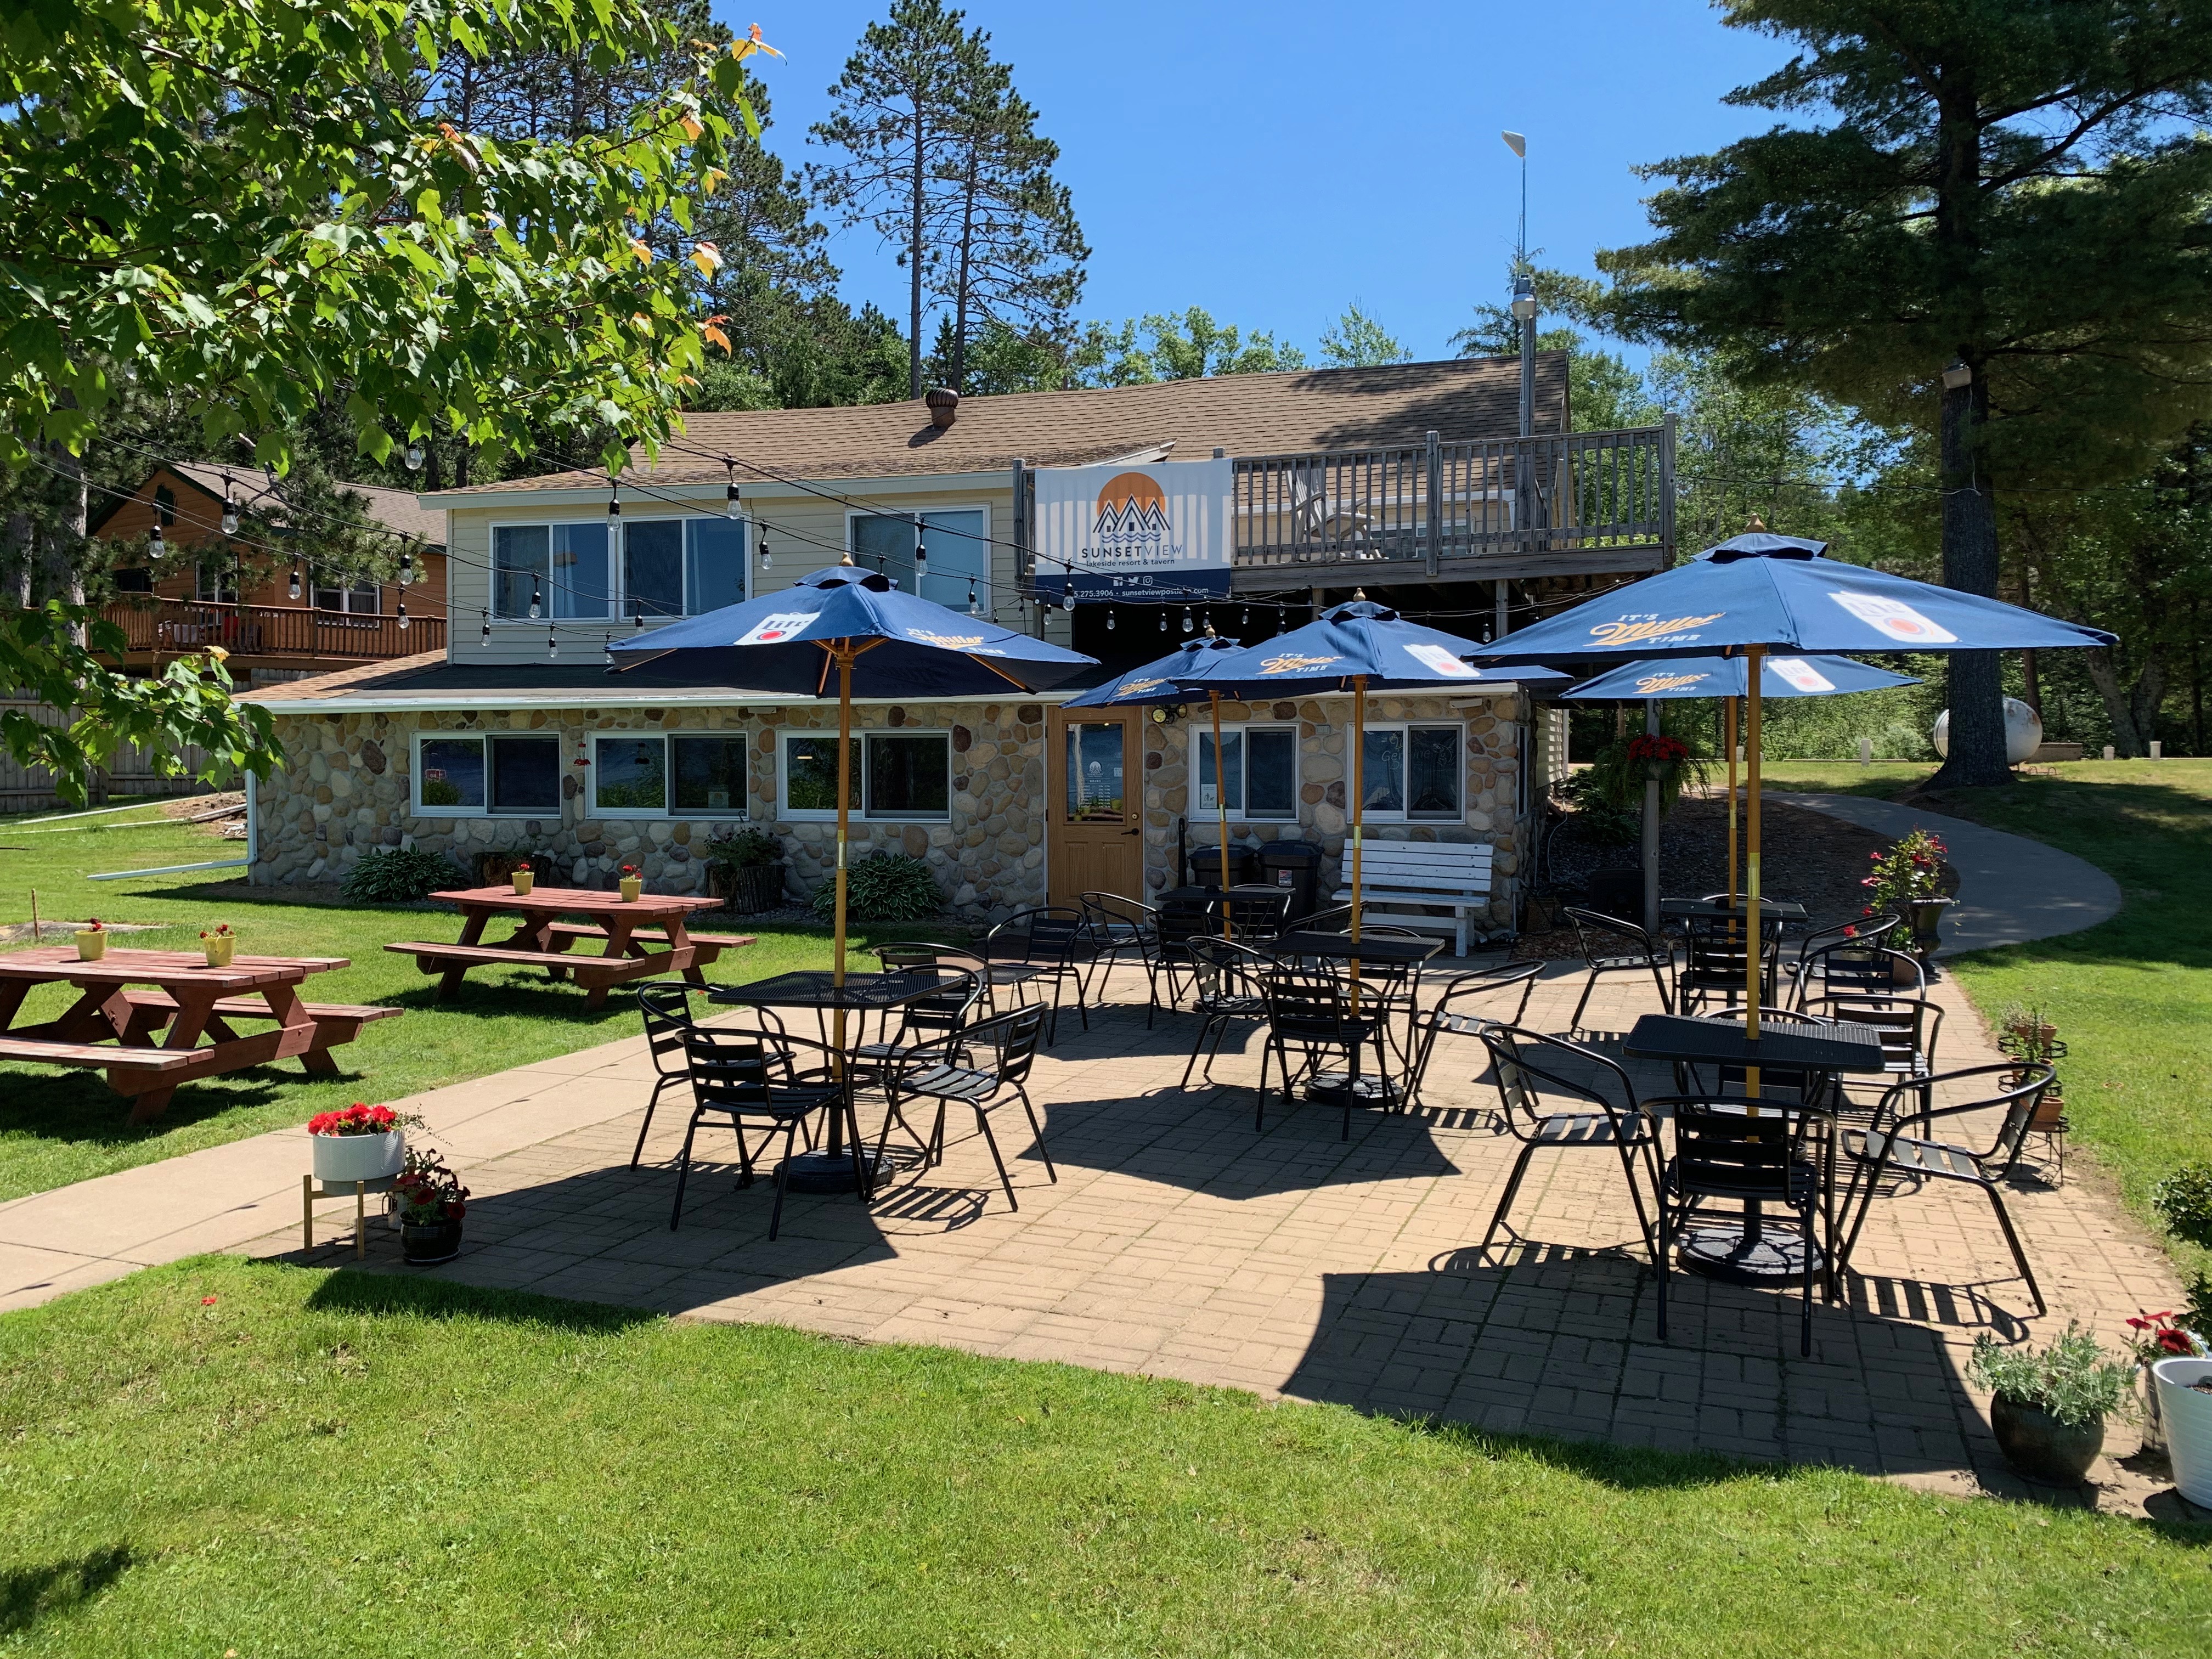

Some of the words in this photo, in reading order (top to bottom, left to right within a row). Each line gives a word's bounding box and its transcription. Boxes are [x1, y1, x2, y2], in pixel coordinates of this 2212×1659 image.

[1073, 589, 1114, 597] 5.275.3906
[1617, 613, 1659, 622] IT'S
[1588, 612, 1726, 644] Miller
[1648, 634, 1702, 645] TIME
